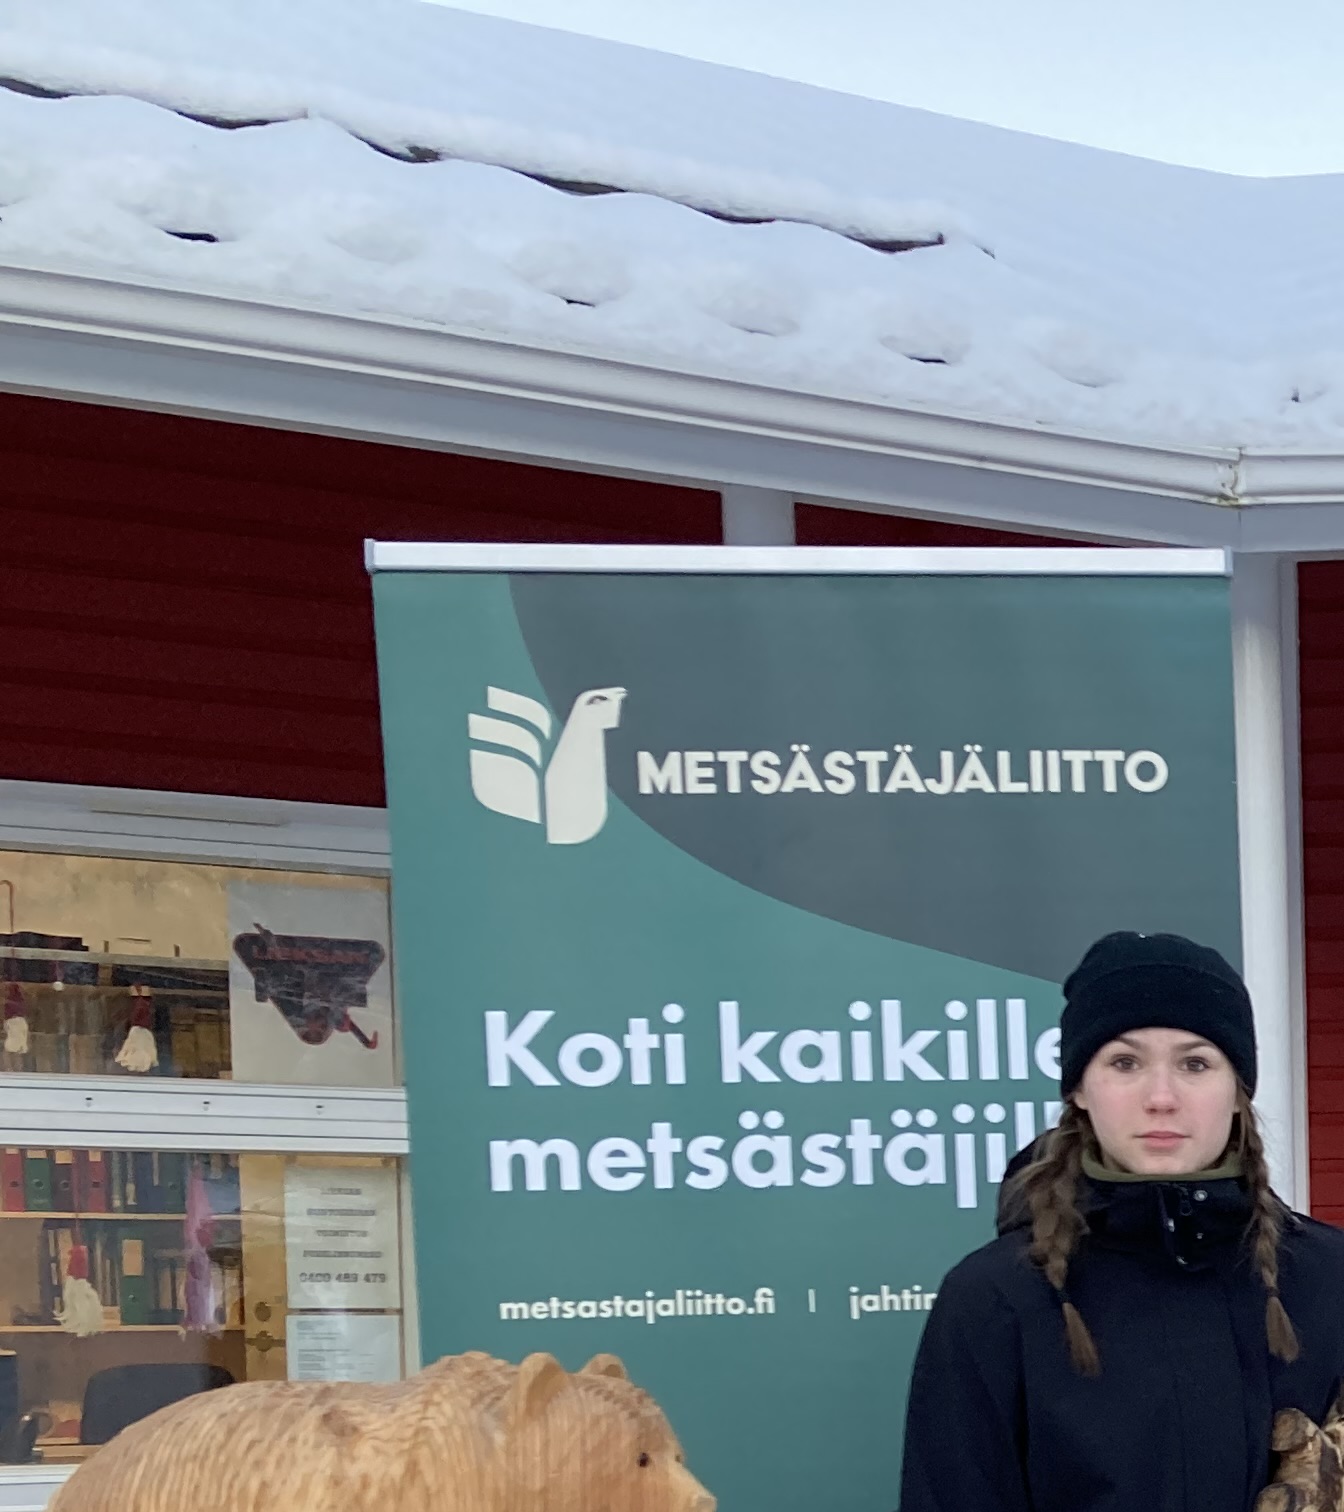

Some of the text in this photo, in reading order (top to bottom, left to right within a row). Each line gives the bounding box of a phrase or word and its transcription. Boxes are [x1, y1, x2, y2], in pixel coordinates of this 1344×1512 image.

[637, 744, 1169, 795] METSÄSTÄJÄLIITTO
[484, 1002, 687, 1088] Koti
[498, 1286, 777, 1326] metsastajaliitto.fi
